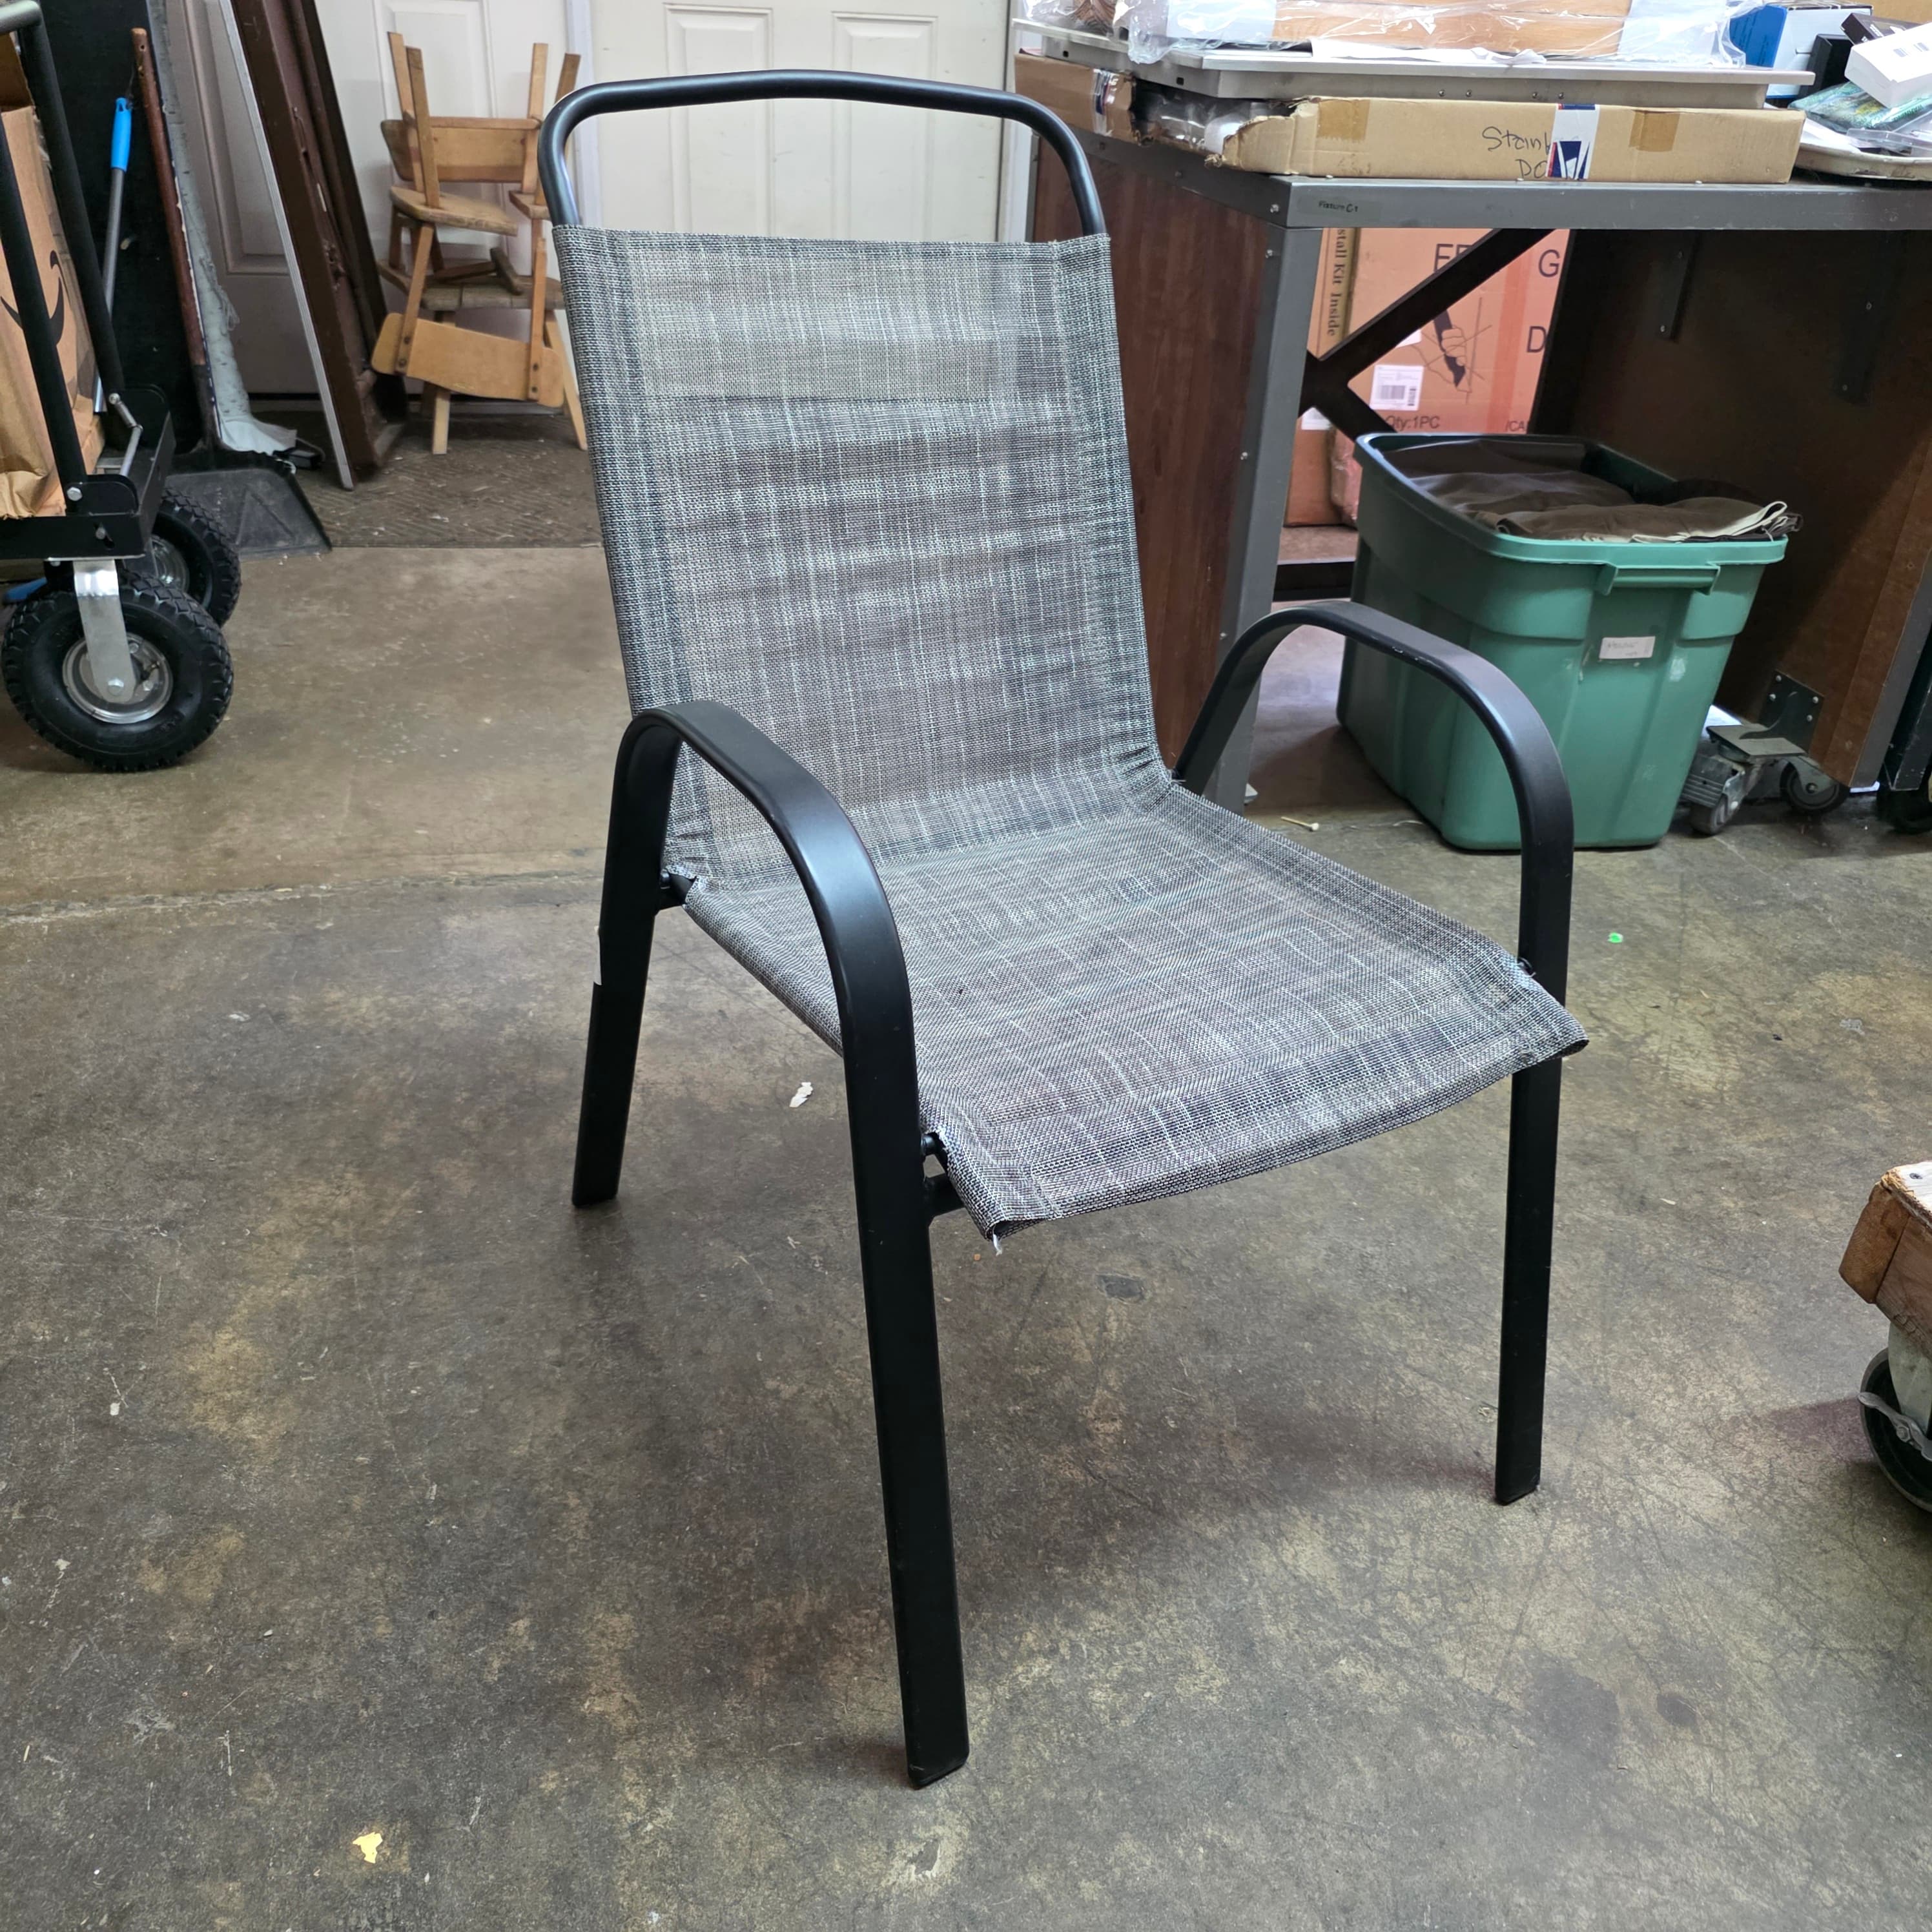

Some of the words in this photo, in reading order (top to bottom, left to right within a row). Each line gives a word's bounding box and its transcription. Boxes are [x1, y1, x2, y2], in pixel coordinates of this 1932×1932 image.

[1335, 229, 1348, 258] stall
[1332, 263, 1346, 285] Kit
[1327, 293, 1342, 336] Inside
